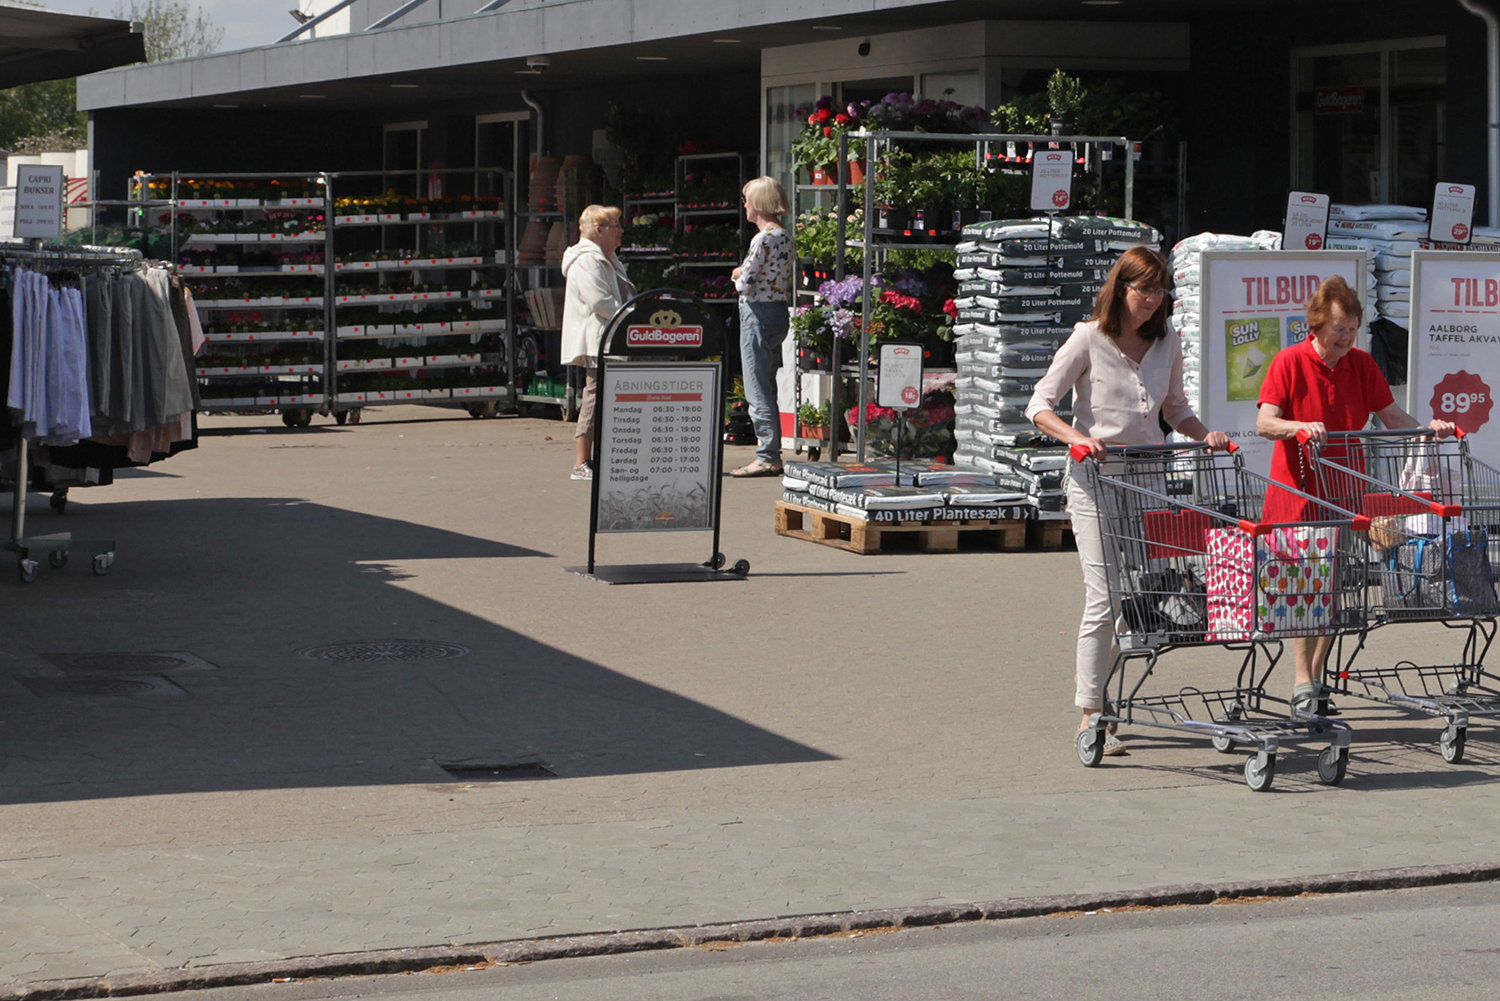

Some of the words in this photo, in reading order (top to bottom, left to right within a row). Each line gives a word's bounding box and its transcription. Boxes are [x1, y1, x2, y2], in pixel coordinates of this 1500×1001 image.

[28, 175, 52, 183] CAPRI
[1108, 228, 1141, 238] Pottemuld
[1050, 242, 1083, 250] Pottemuld
[1050, 270, 1083, 278] Pottemuld
[1047, 298, 1081, 306] Pottemuld
[1232, 321, 1259, 337] SUN
[1293, 322, 1309, 334] SU
[1429, 324, 1478, 333] AALBORG
[629, 329, 700, 343] GuldBageren
[1232, 331, 1260, 346] LOLLY
[1429, 334, 1466, 343] TAFFEL
[614, 379, 704, 391] ÅBNINGSTIDER
[875, 510, 894, 521] 40
[897, 510, 929, 521] Liter
[933, 507, 1006, 520] Plantesæk
